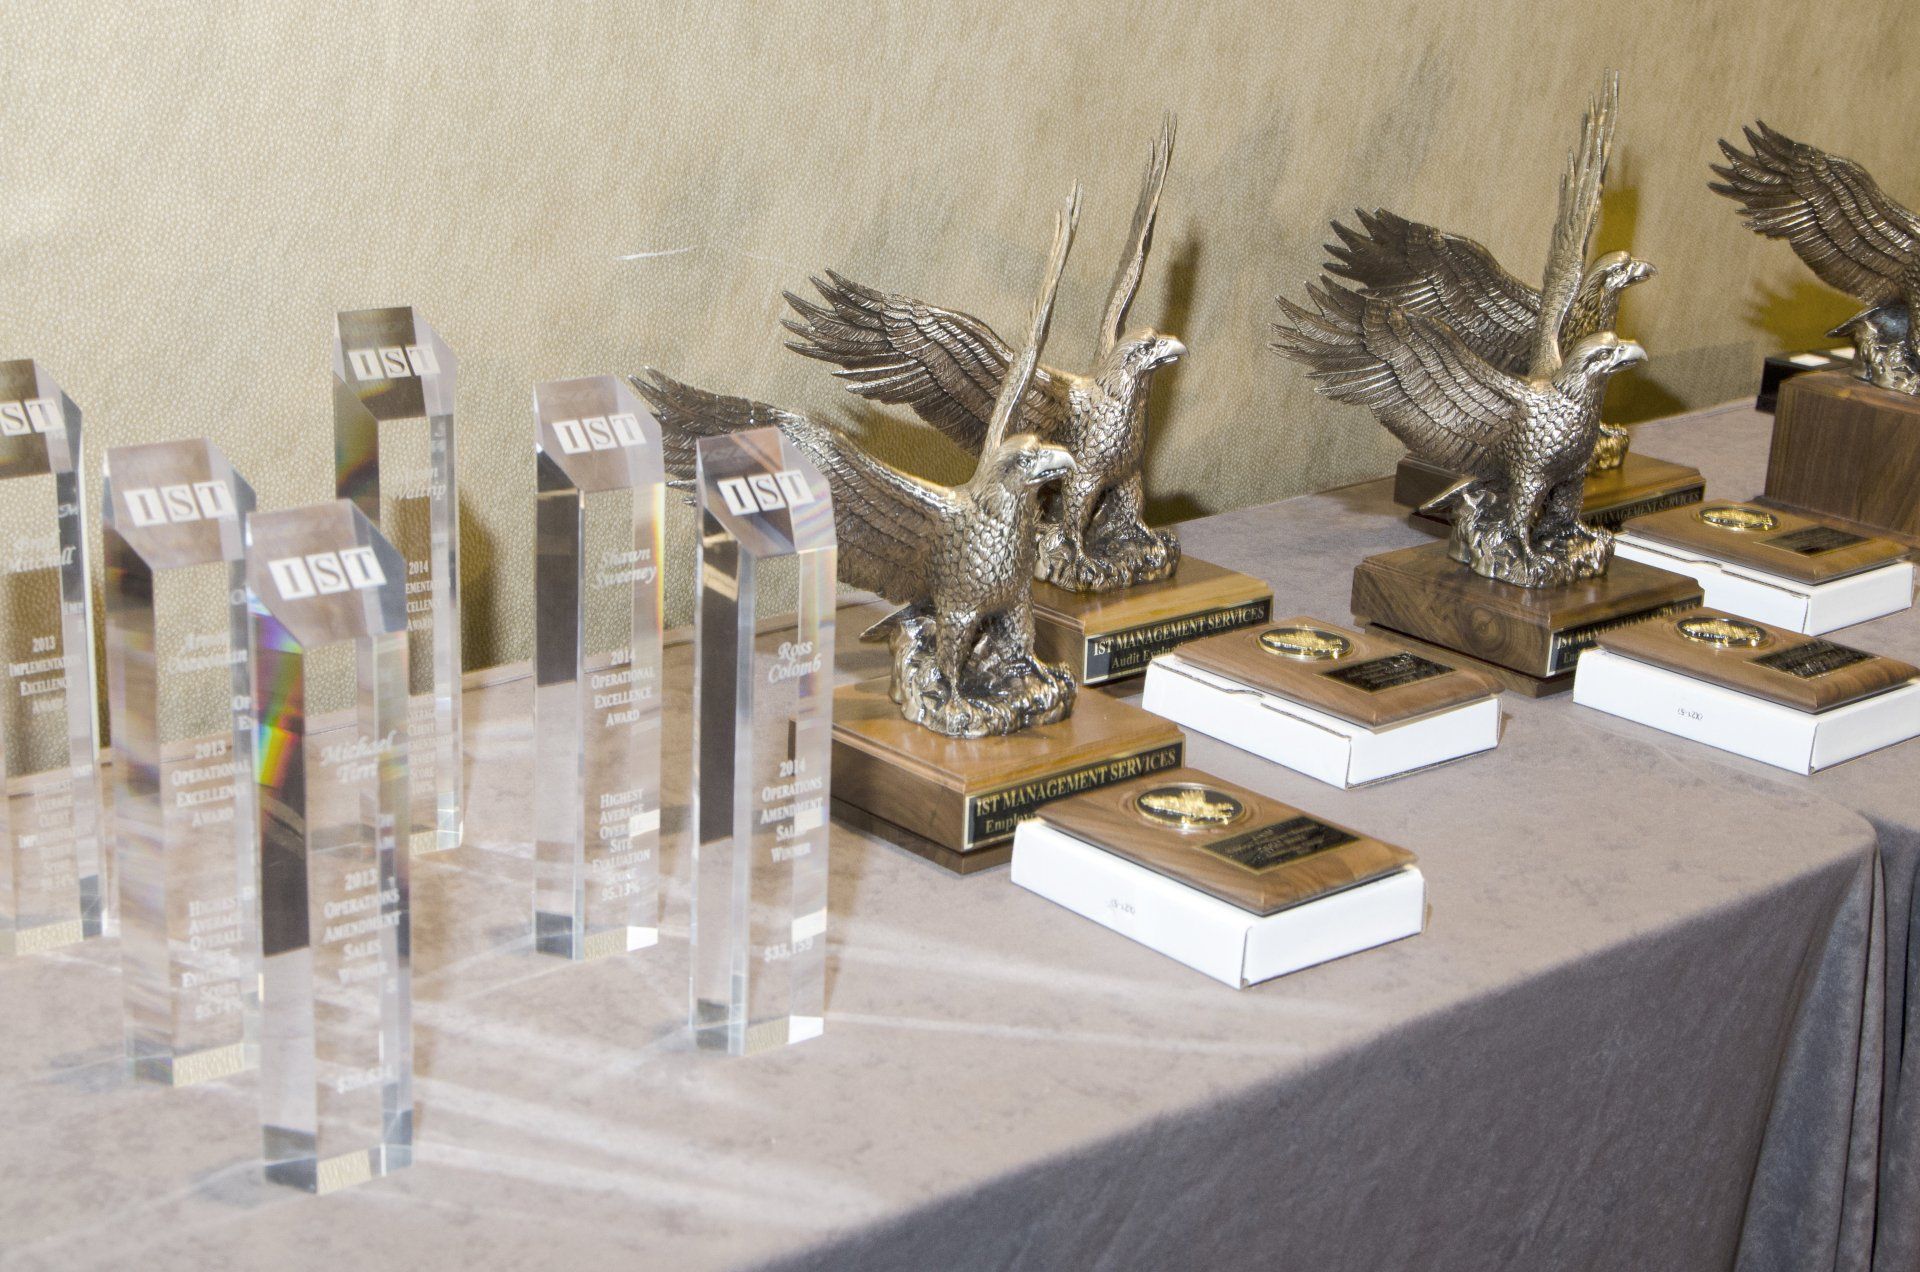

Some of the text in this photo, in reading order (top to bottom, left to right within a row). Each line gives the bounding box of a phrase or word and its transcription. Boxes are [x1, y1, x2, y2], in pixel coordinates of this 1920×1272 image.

[350, 347, 438, 378] IST
[554, 415, 644, 452] IST
[127, 483, 234, 525] IST
[720, 473, 811, 513] IST
[272, 549, 384, 597] IST
[409, 560, 429, 574] 2014
[1093, 605, 1265, 657] IST MANAGEMENT SERVICES
[32, 634, 56, 653] 2013
[777, 640, 814, 661] Ross
[611, 648, 636, 665] 2014
[1111, 651, 1141, 670] Audit
[592, 666, 656, 690] OPERATIONAL
[594, 686, 653, 709] EXCELLENCE
[605, 708, 640, 728] AWARD
[194, 739, 227, 759] 2013
[779, 757, 805, 778] 2014
[761, 776, 823, 802] OPERATIONS
[976, 748, 1176, 817] IST MANAGEMENT SERVICES
[600, 788, 644, 809] HIGHEST
[760, 797, 823, 825] AMENDMENT
[609, 837, 634, 854] SITE
[344, 867, 379, 891] 2013
[324, 886, 400, 919] OPERATIONS
[322, 909, 401, 944] AMENDMENT
[343, 939, 382, 961] SALES
